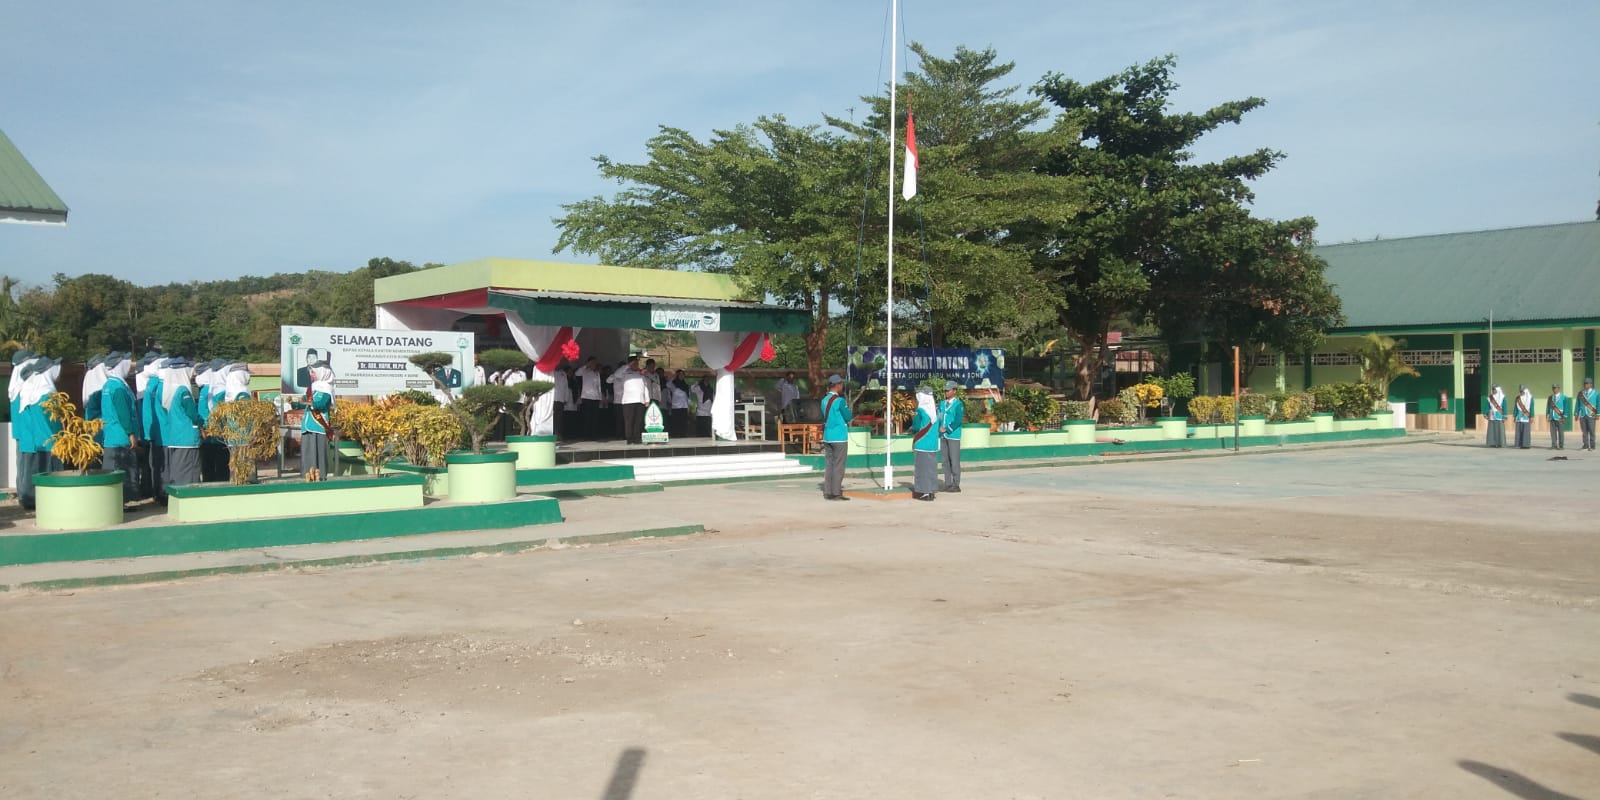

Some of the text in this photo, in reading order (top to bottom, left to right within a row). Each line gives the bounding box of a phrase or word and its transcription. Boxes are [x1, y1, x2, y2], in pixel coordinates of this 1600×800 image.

[668, 318, 700, 328] KOPIAH ART
[330, 335, 432, 347] SELAMAT DATANG
[893, 356, 969, 370] SELAMAT DATANG
